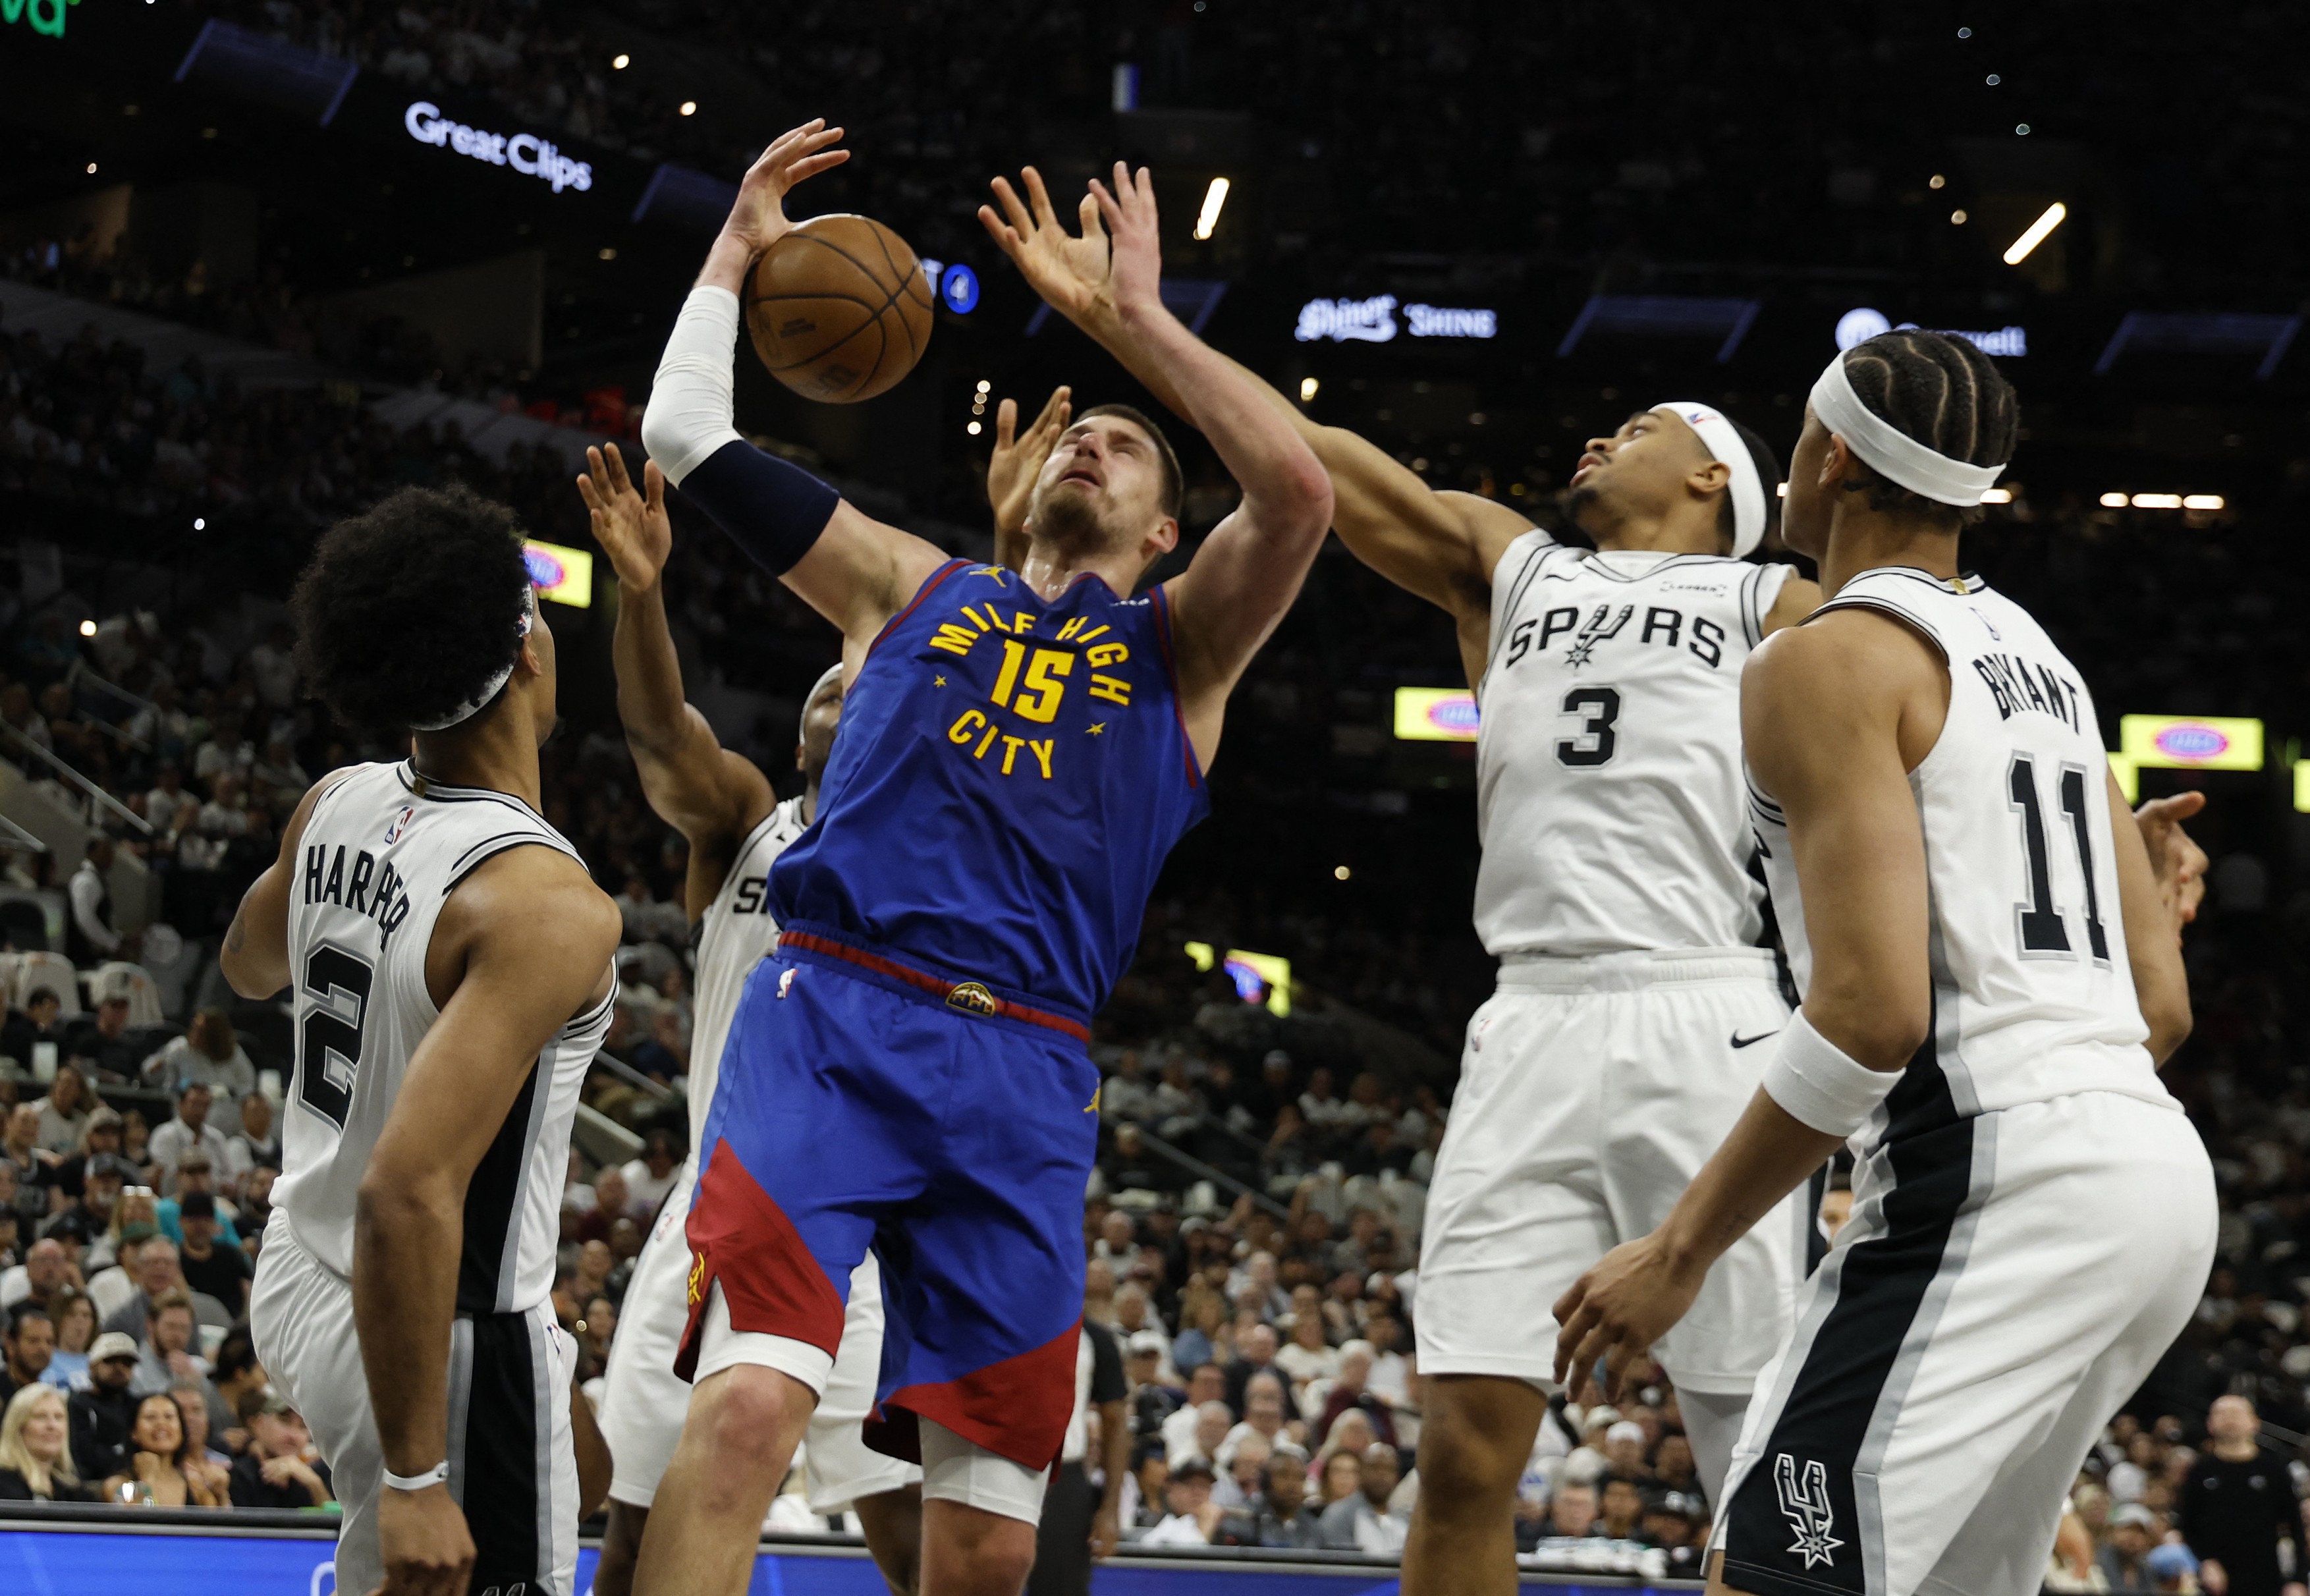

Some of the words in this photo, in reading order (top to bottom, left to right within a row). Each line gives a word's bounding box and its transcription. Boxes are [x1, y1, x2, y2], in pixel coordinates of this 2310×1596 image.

[404, 101, 507, 165] Great
[507, 134, 592, 194] Clips
[990, 638, 1076, 724] 15
[1055, 615, 1132, 707] HIGH
[1506, 604, 1725, 669] SPURS
[1554, 684, 1622, 769] 3
[1971, 653, 2080, 736] BRYANT
[948, 709, 1055, 779] CITY
[305, 844, 410, 954] HARPER
[2007, 750, 2112, 972] 11
[298, 938, 375, 1142] 2
